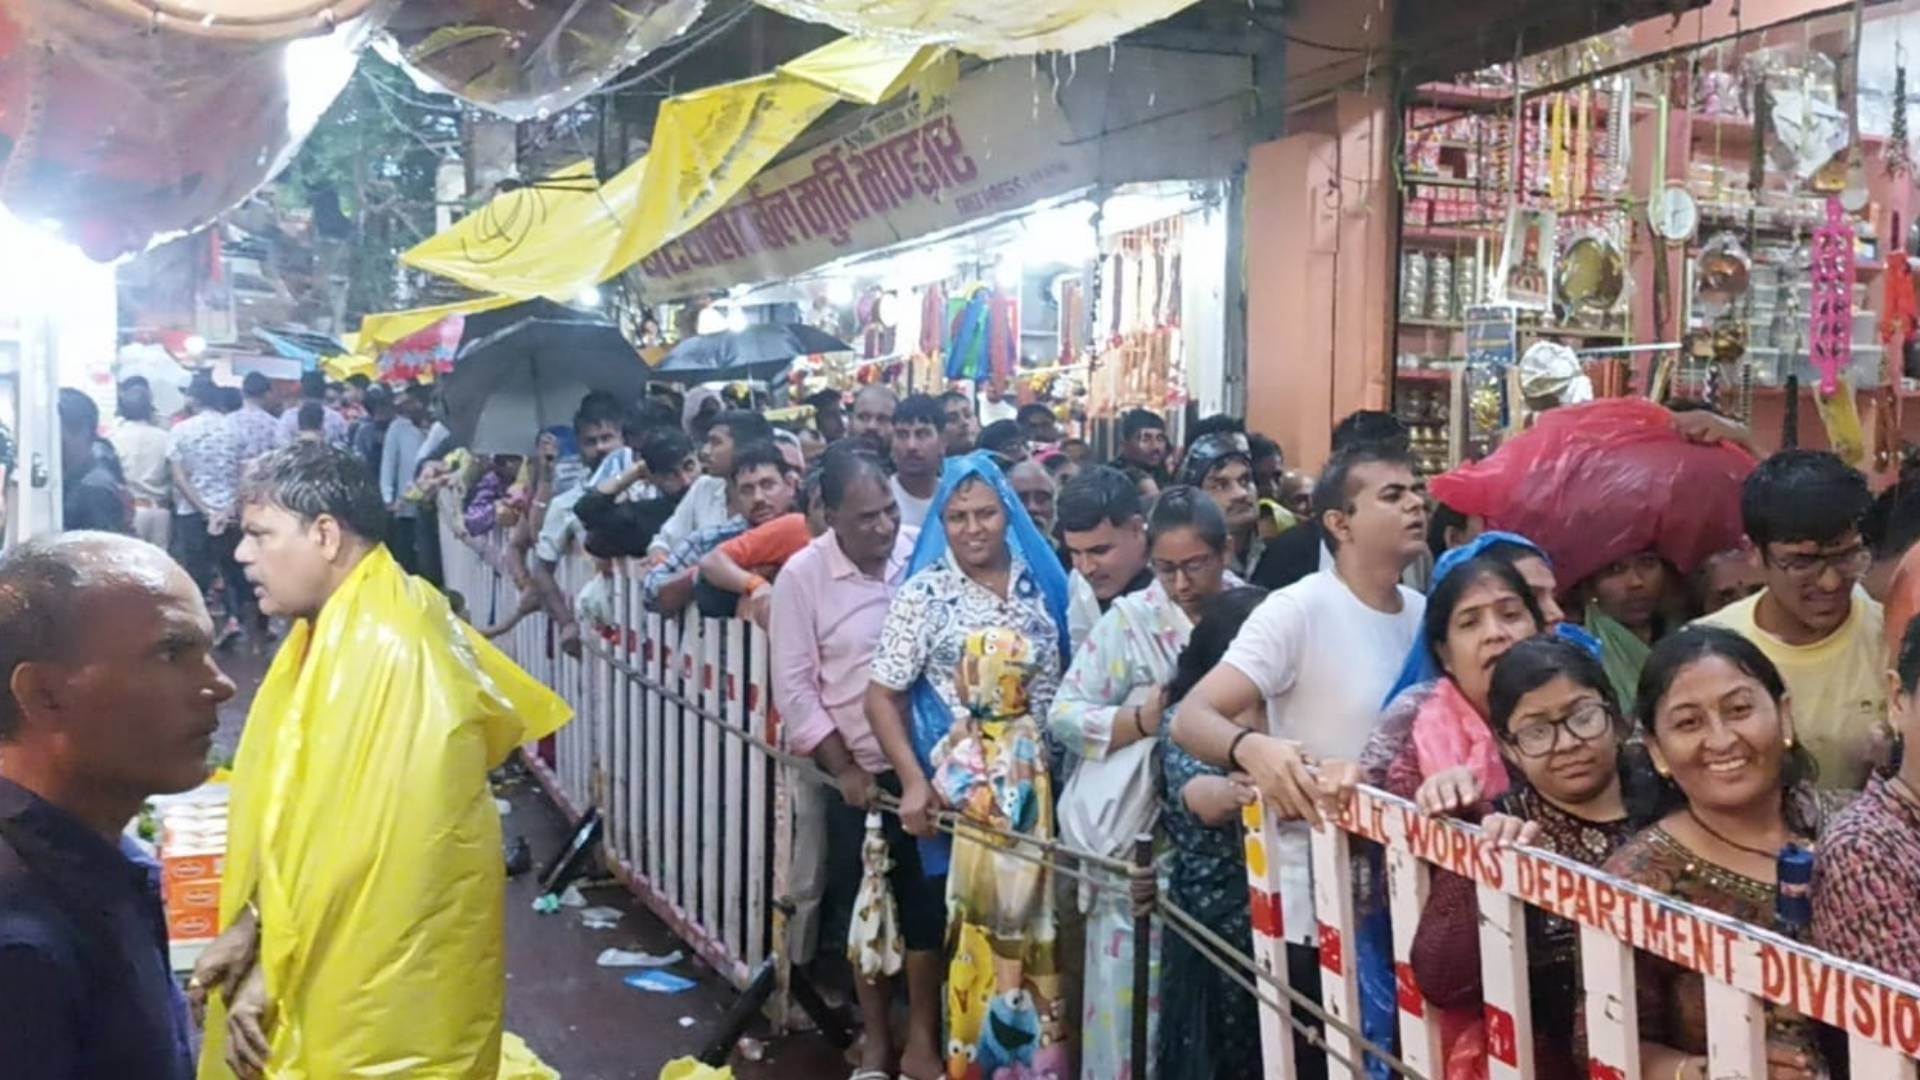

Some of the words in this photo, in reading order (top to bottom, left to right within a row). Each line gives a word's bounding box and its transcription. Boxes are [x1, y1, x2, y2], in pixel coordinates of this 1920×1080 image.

[1402, 805, 1503, 889] WORKS
[1516, 853, 1739, 985] DEPARTMENT
[1761, 943, 1920, 1054] DIVISIO
